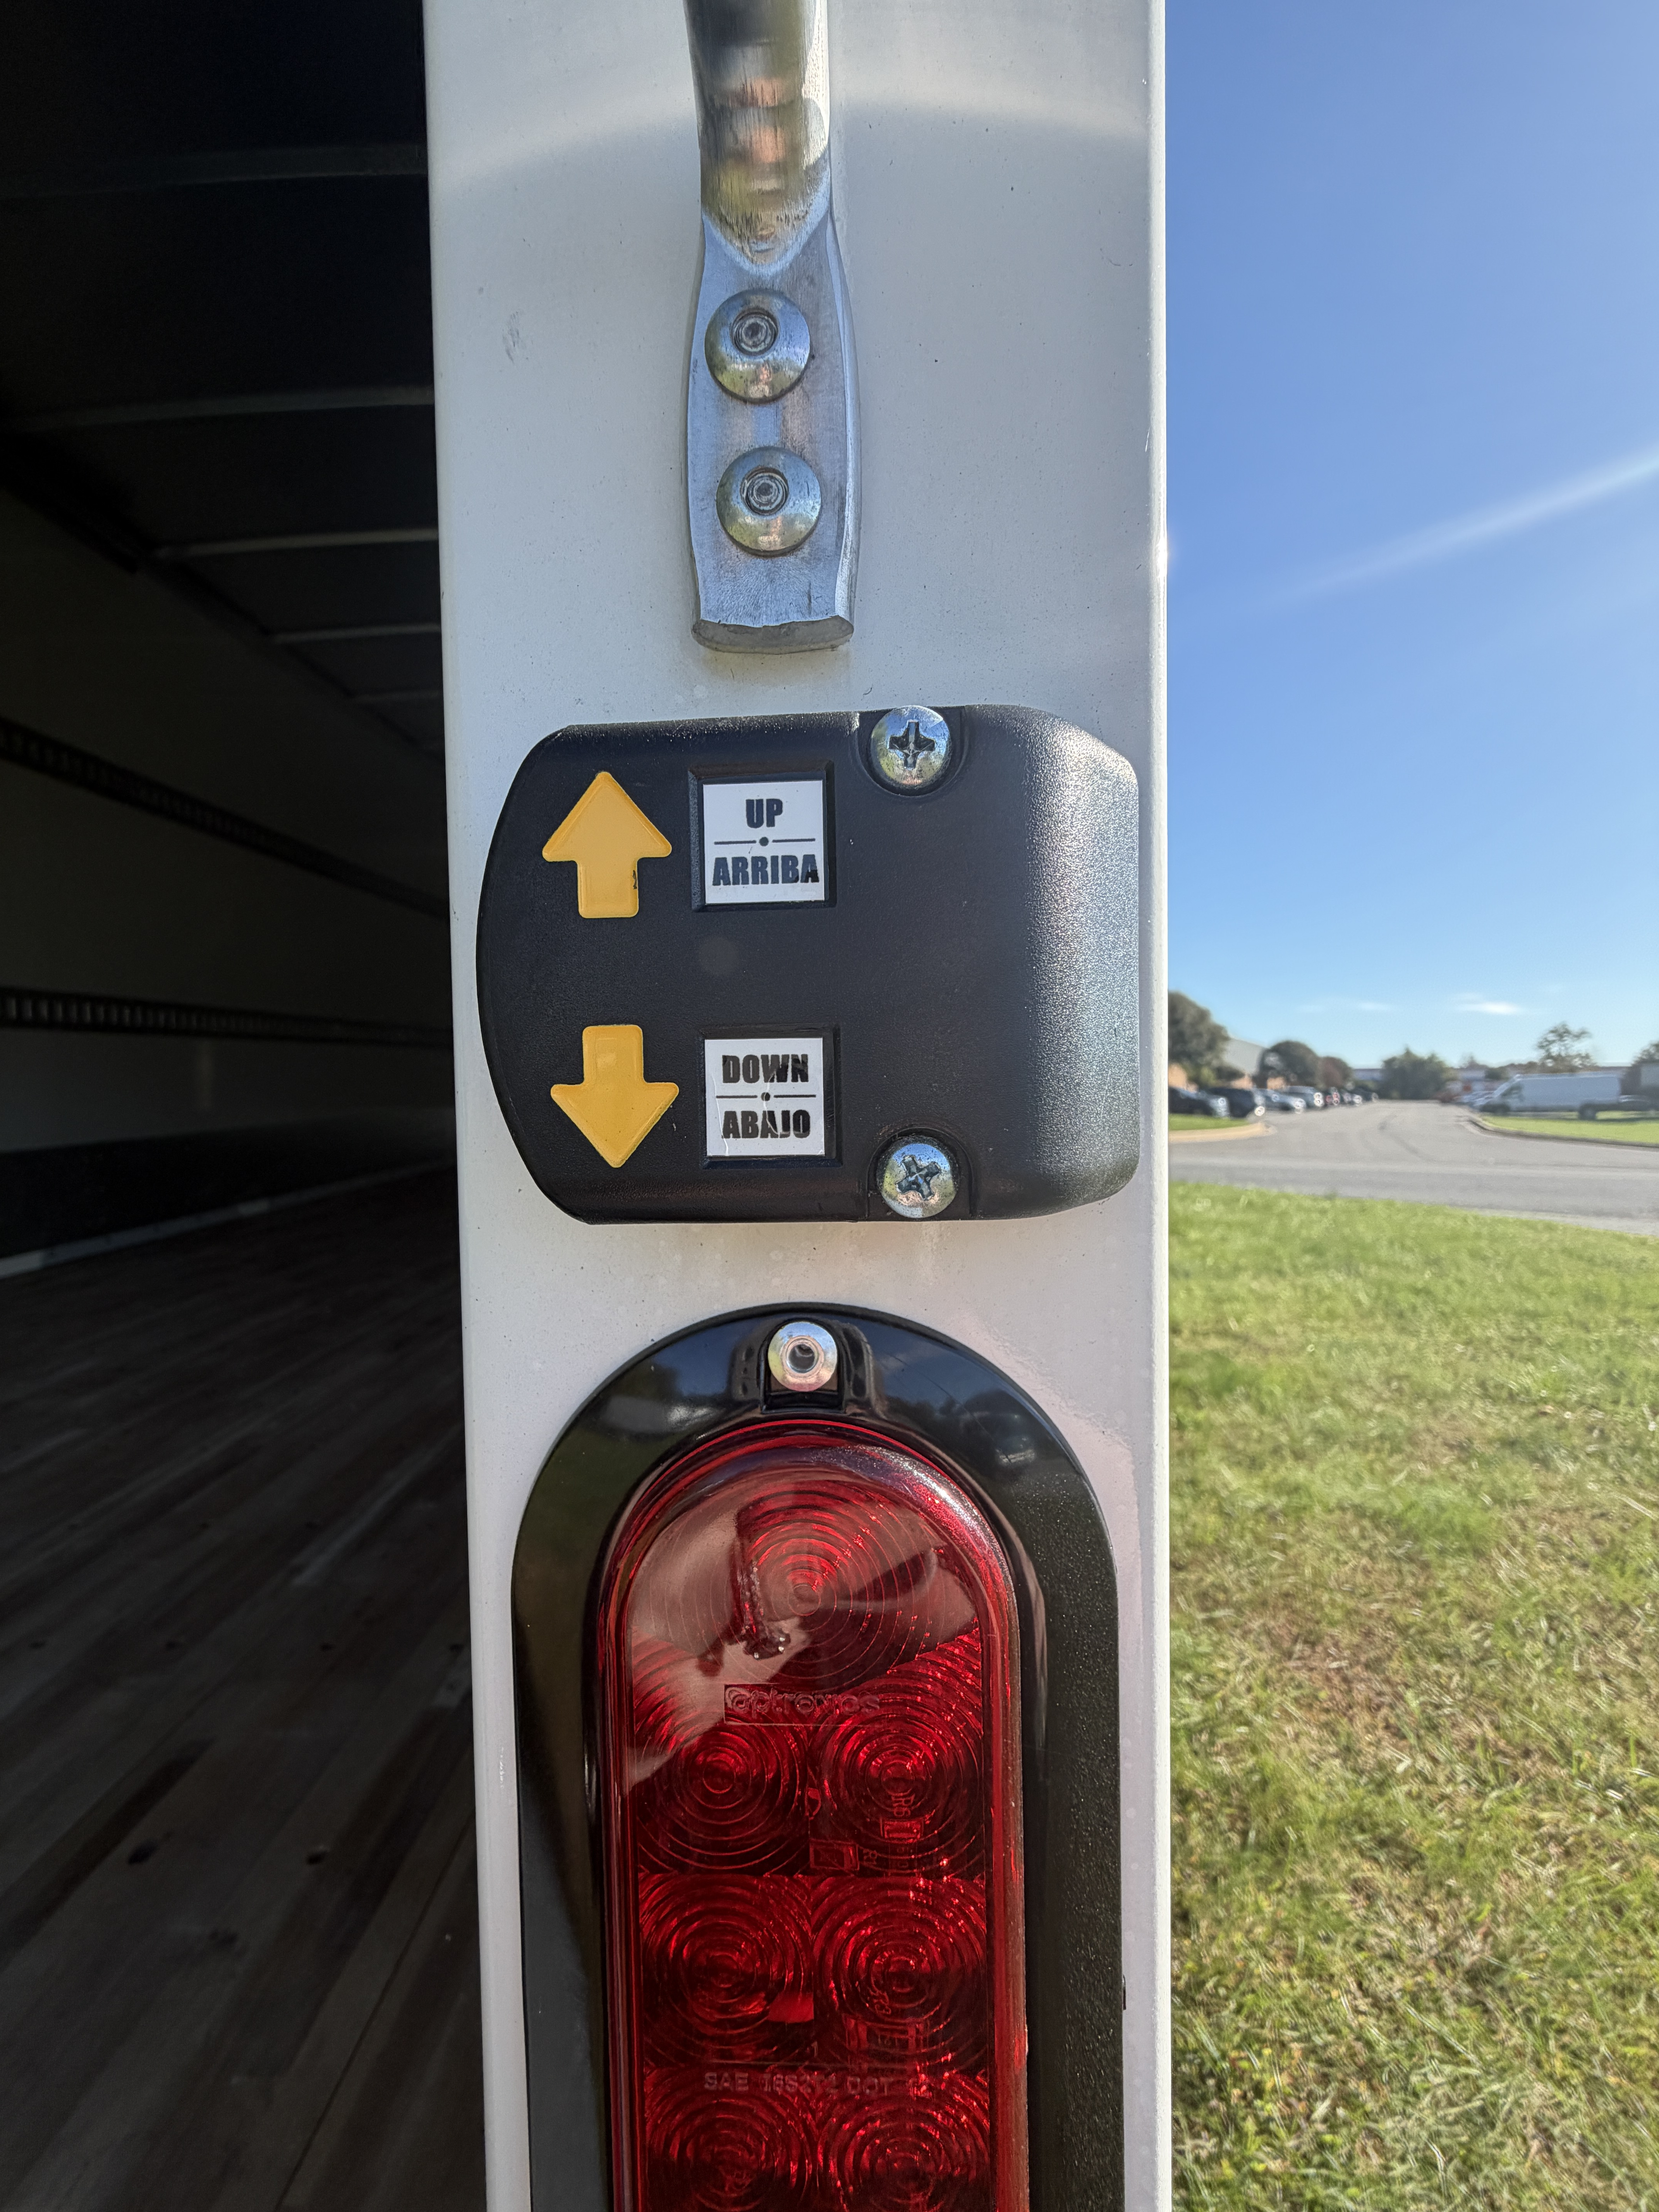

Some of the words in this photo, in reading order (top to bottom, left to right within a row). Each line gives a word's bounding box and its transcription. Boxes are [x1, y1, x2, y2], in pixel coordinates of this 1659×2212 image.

[745, 798, 783, 829] UP
[712, 854, 820, 886] ARRIBA
[722, 1054, 809, 1084] DOWN
[721, 1109, 811, 1139] ABAJO
[704, 2071, 749, 2092] SAE
